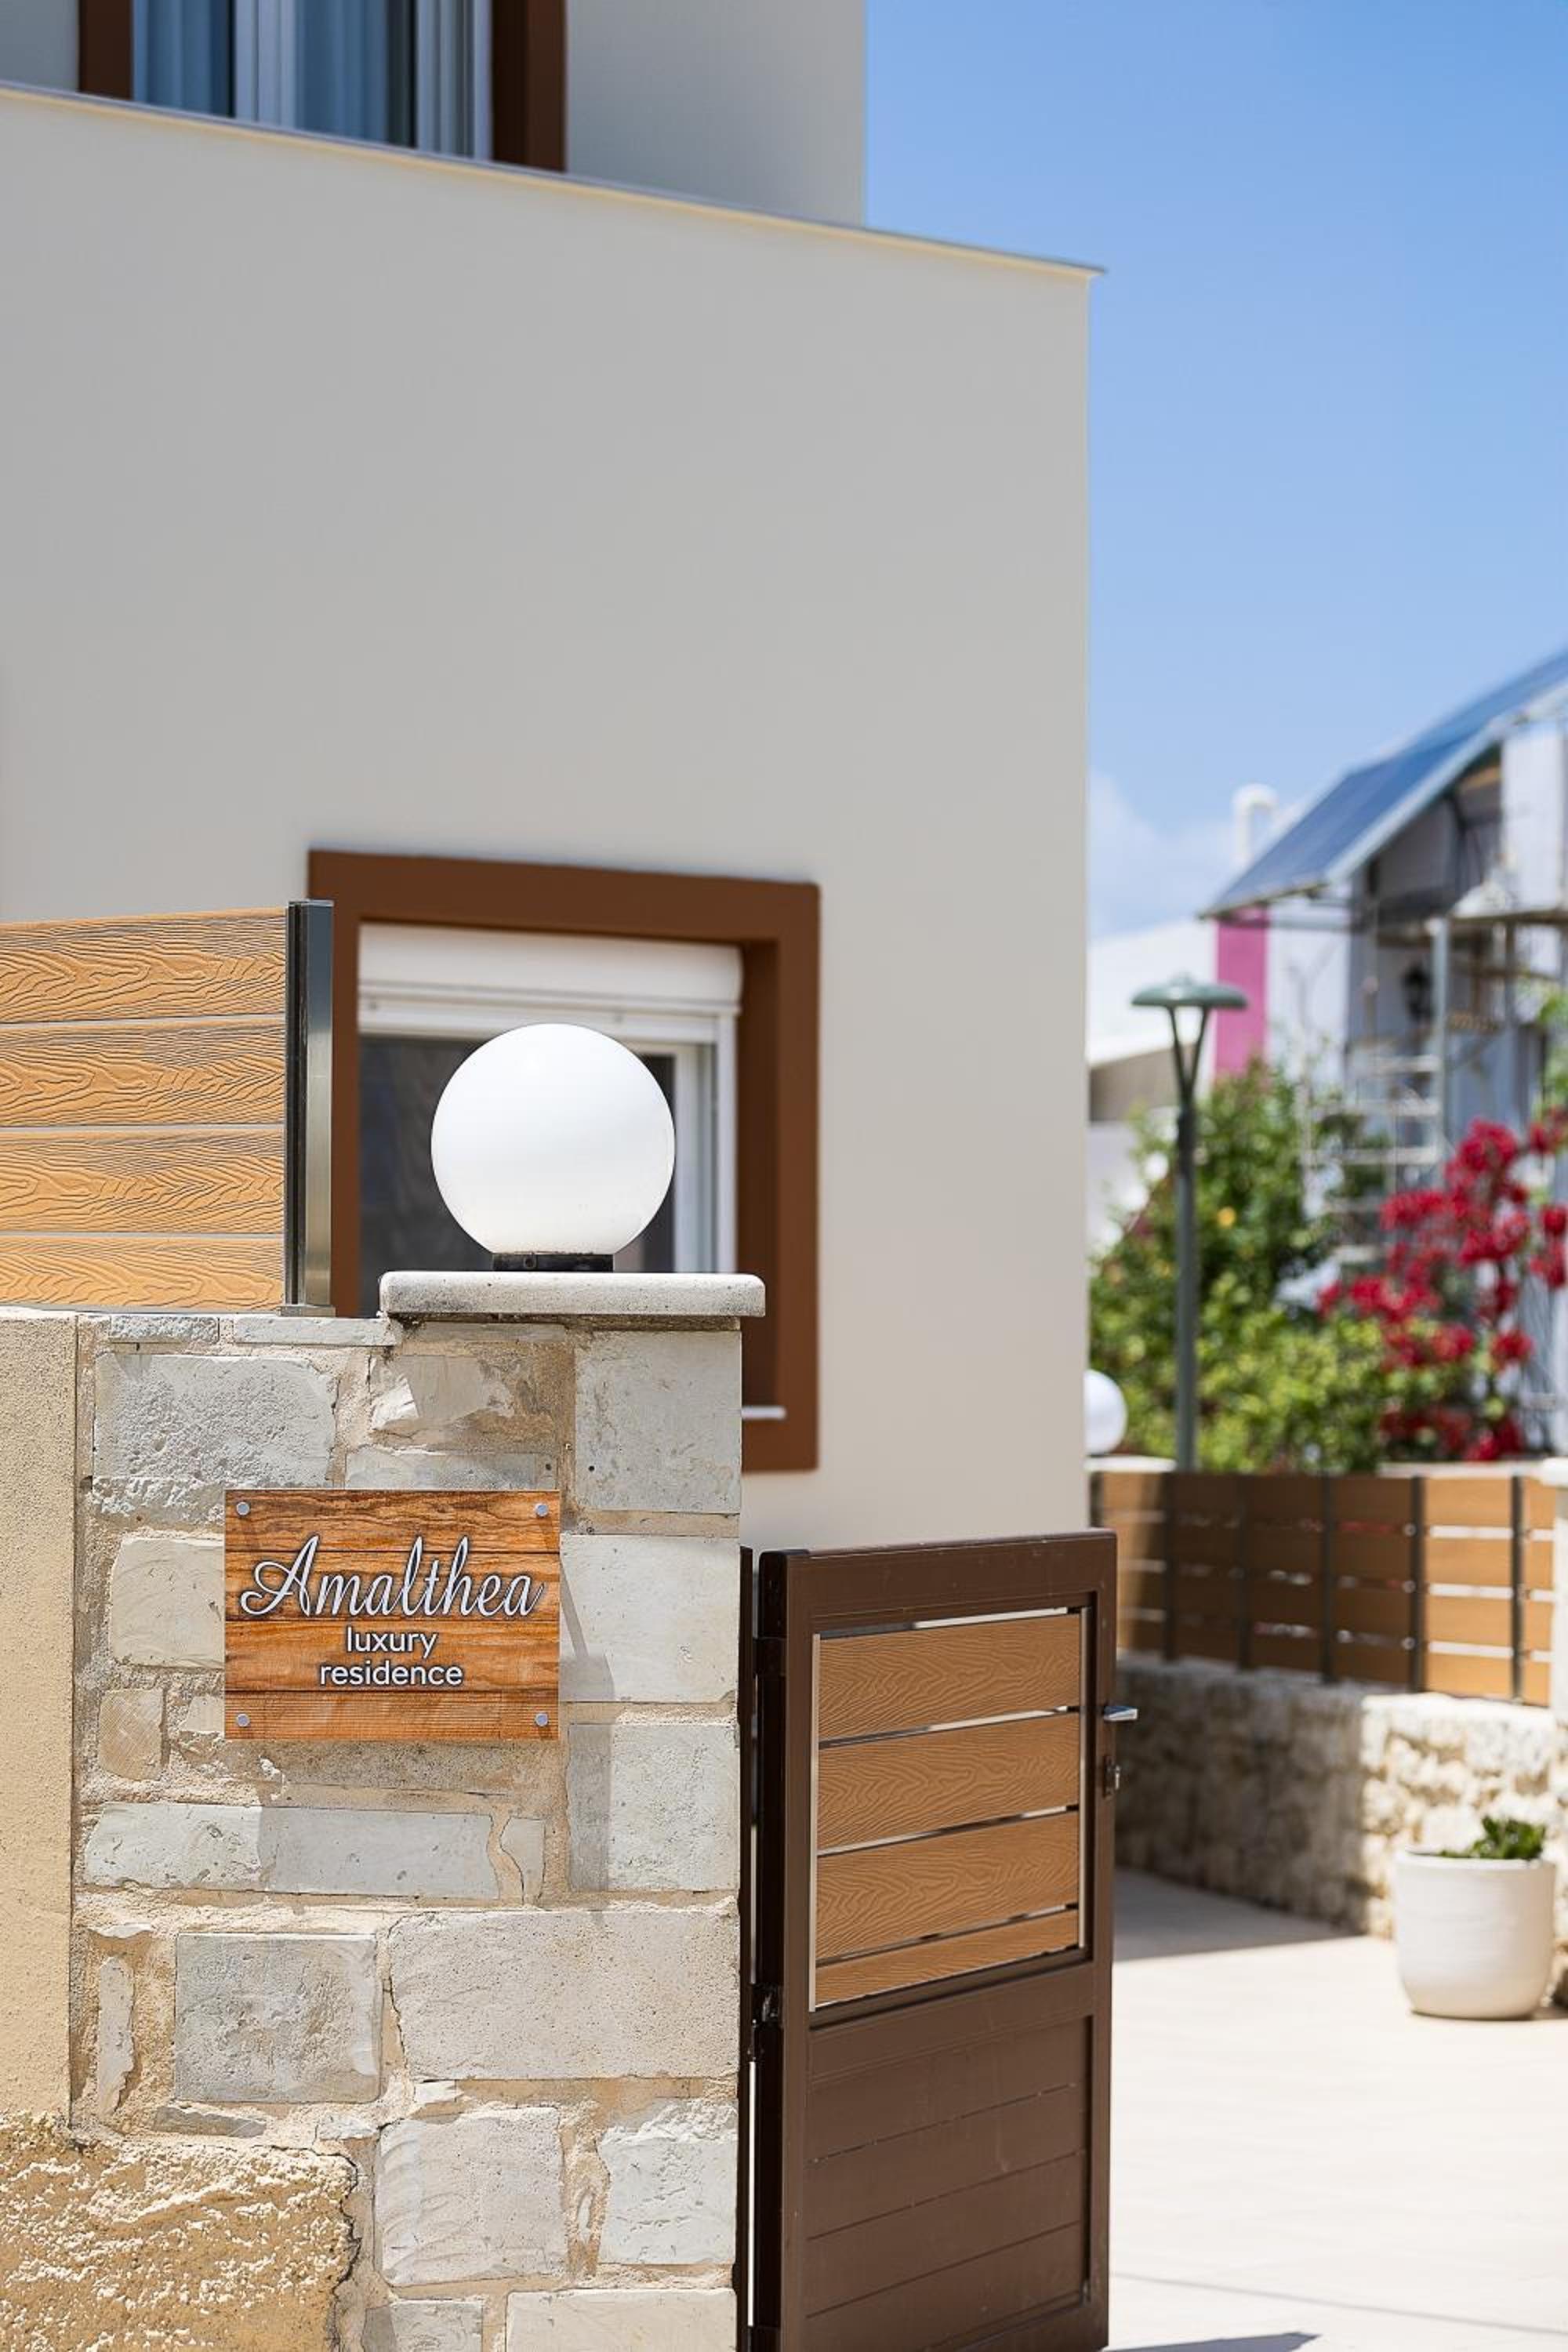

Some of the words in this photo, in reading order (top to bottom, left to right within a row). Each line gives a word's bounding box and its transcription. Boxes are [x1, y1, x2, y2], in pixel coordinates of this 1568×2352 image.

[240, 1535, 544, 1617] Amalthea
[347, 1626, 438, 1658] luxury
[320, 1660, 463, 1686] residence
